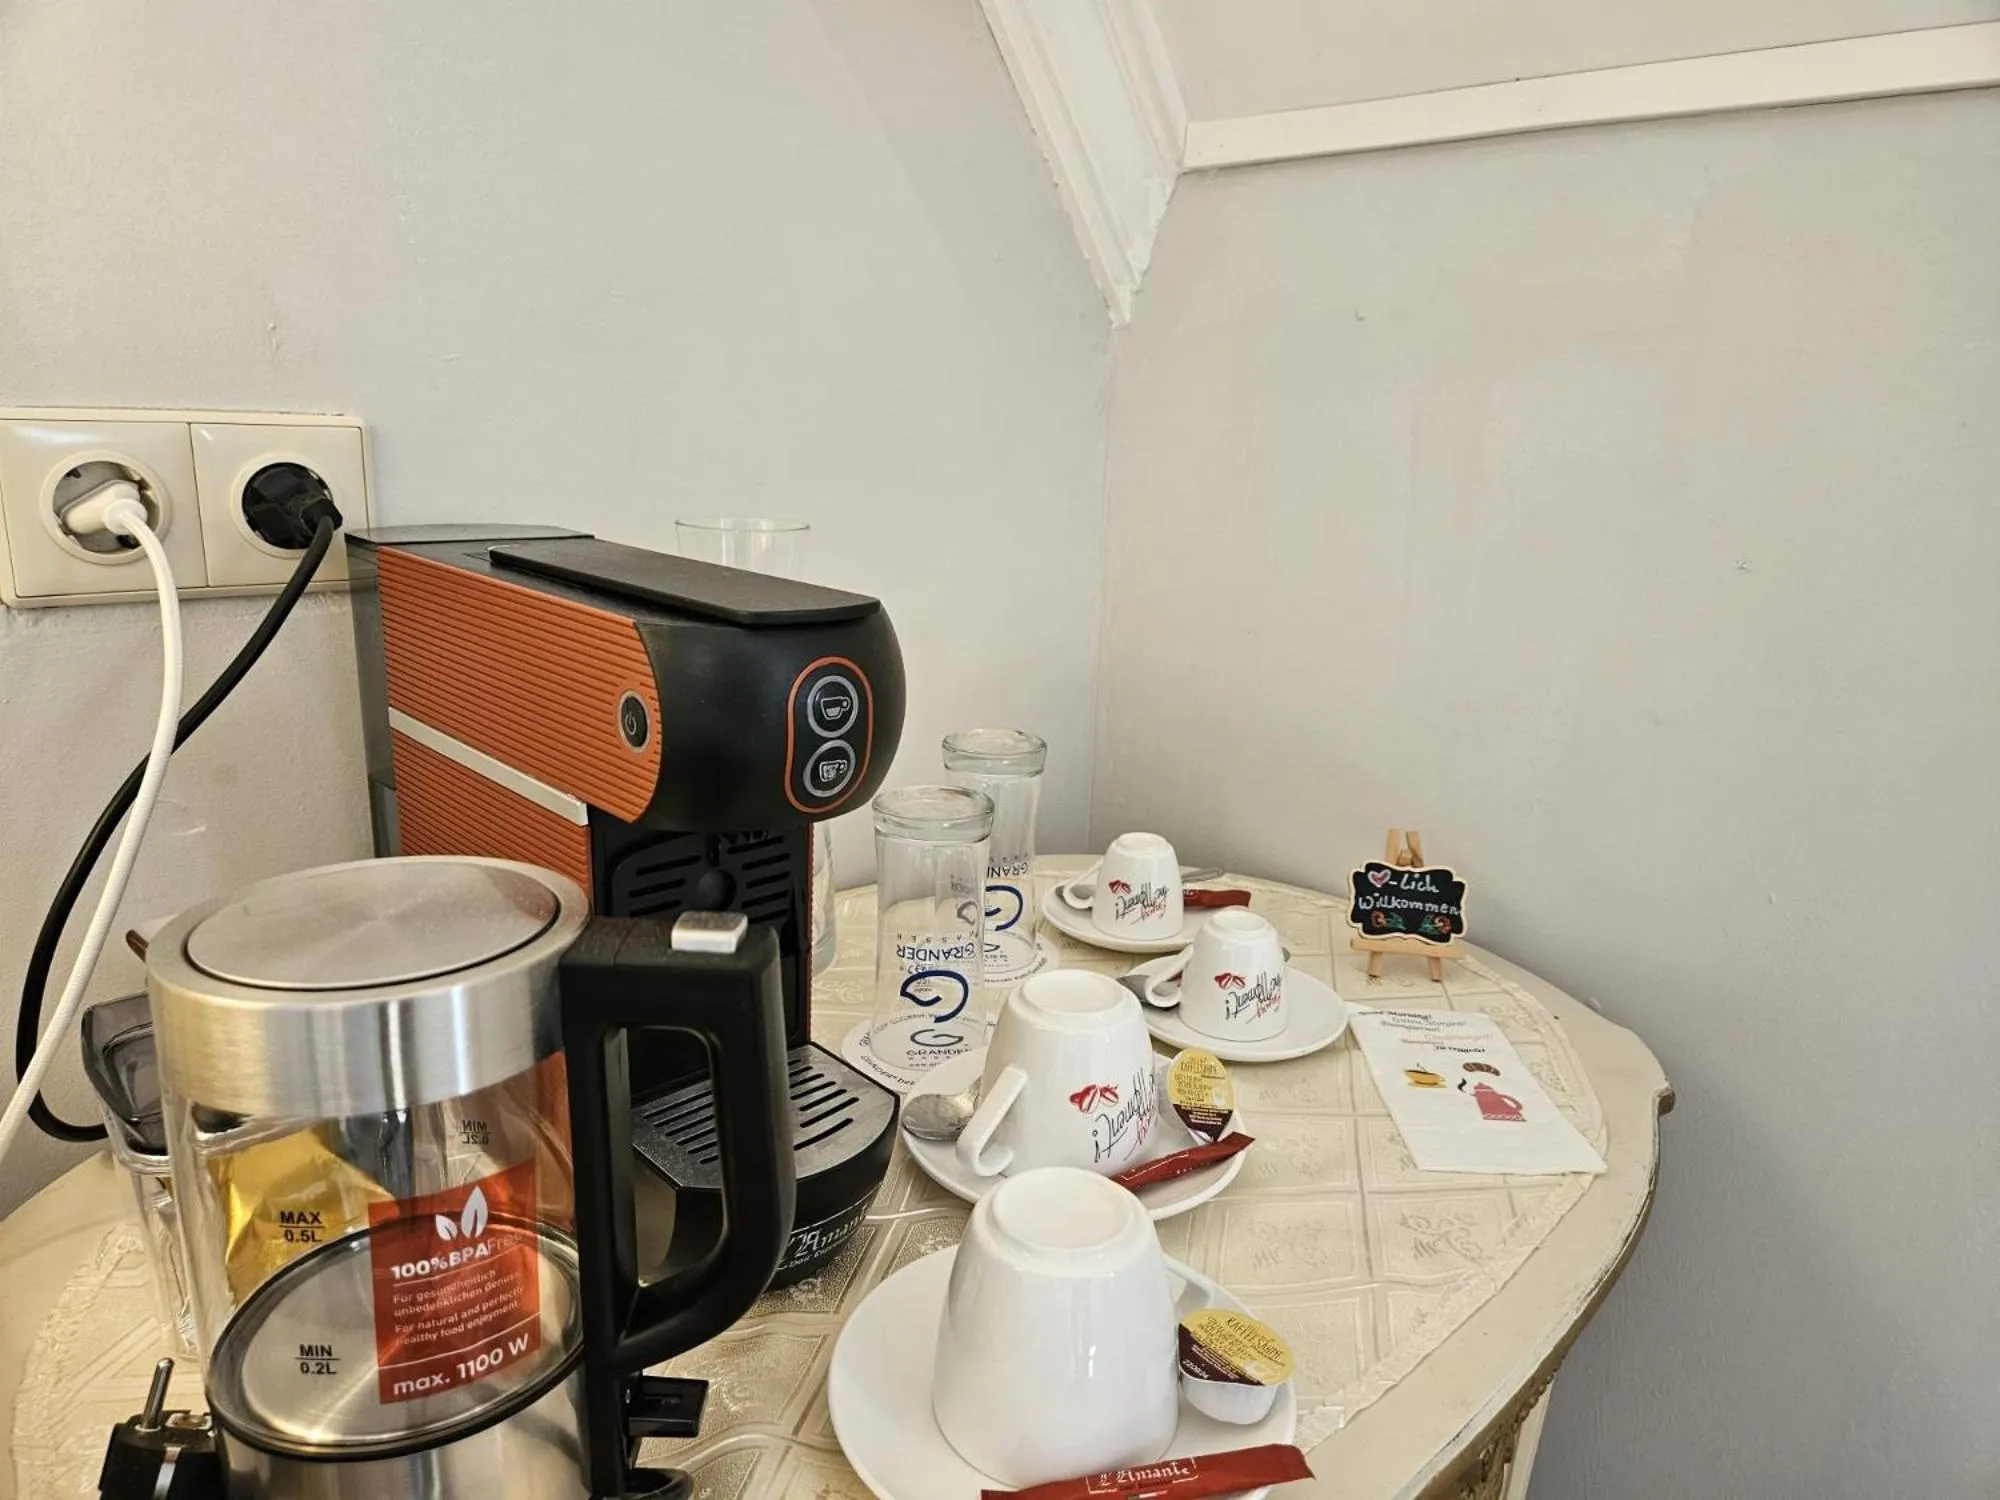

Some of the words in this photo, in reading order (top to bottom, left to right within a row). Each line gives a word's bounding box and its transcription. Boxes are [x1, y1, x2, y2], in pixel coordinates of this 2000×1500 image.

[896, 943, 974, 961] GRANDER
[280, 1210, 322, 1224] MAX
[284, 1229, 322, 1242] 0.5L
[418, 1313, 458, 1329] natural
[460, 1304, 480, 1318] and
[440, 1321, 465, 1336] food
[299, 1343, 332, 1357] MIN
[300, 1361, 338, 1374] 0.2L
[393, 1372, 450, 1395] max.
[456, 1348, 503, 1379] 1100
[508, 1333, 529, 1356] W
